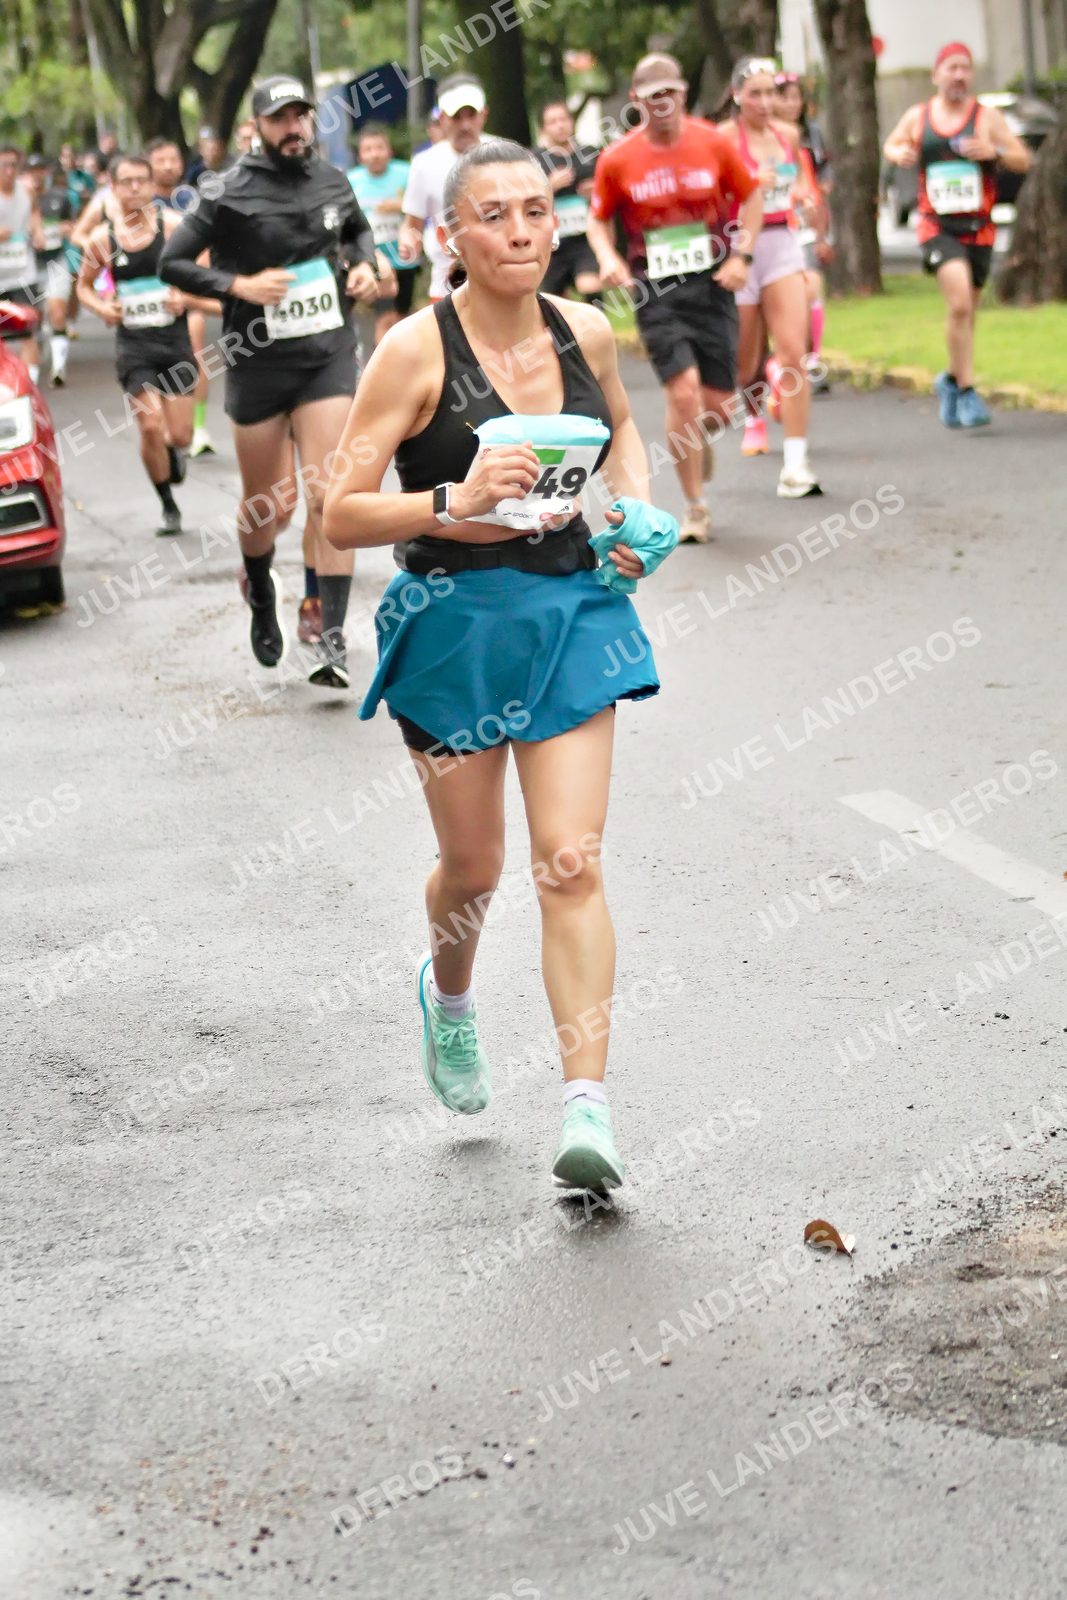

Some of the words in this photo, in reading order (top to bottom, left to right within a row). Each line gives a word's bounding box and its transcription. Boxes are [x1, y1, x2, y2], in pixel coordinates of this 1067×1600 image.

[655, 250, 704, 272] 1418
[272, 293, 333, 322] 4030
[532, 466, 588, 499] 49
